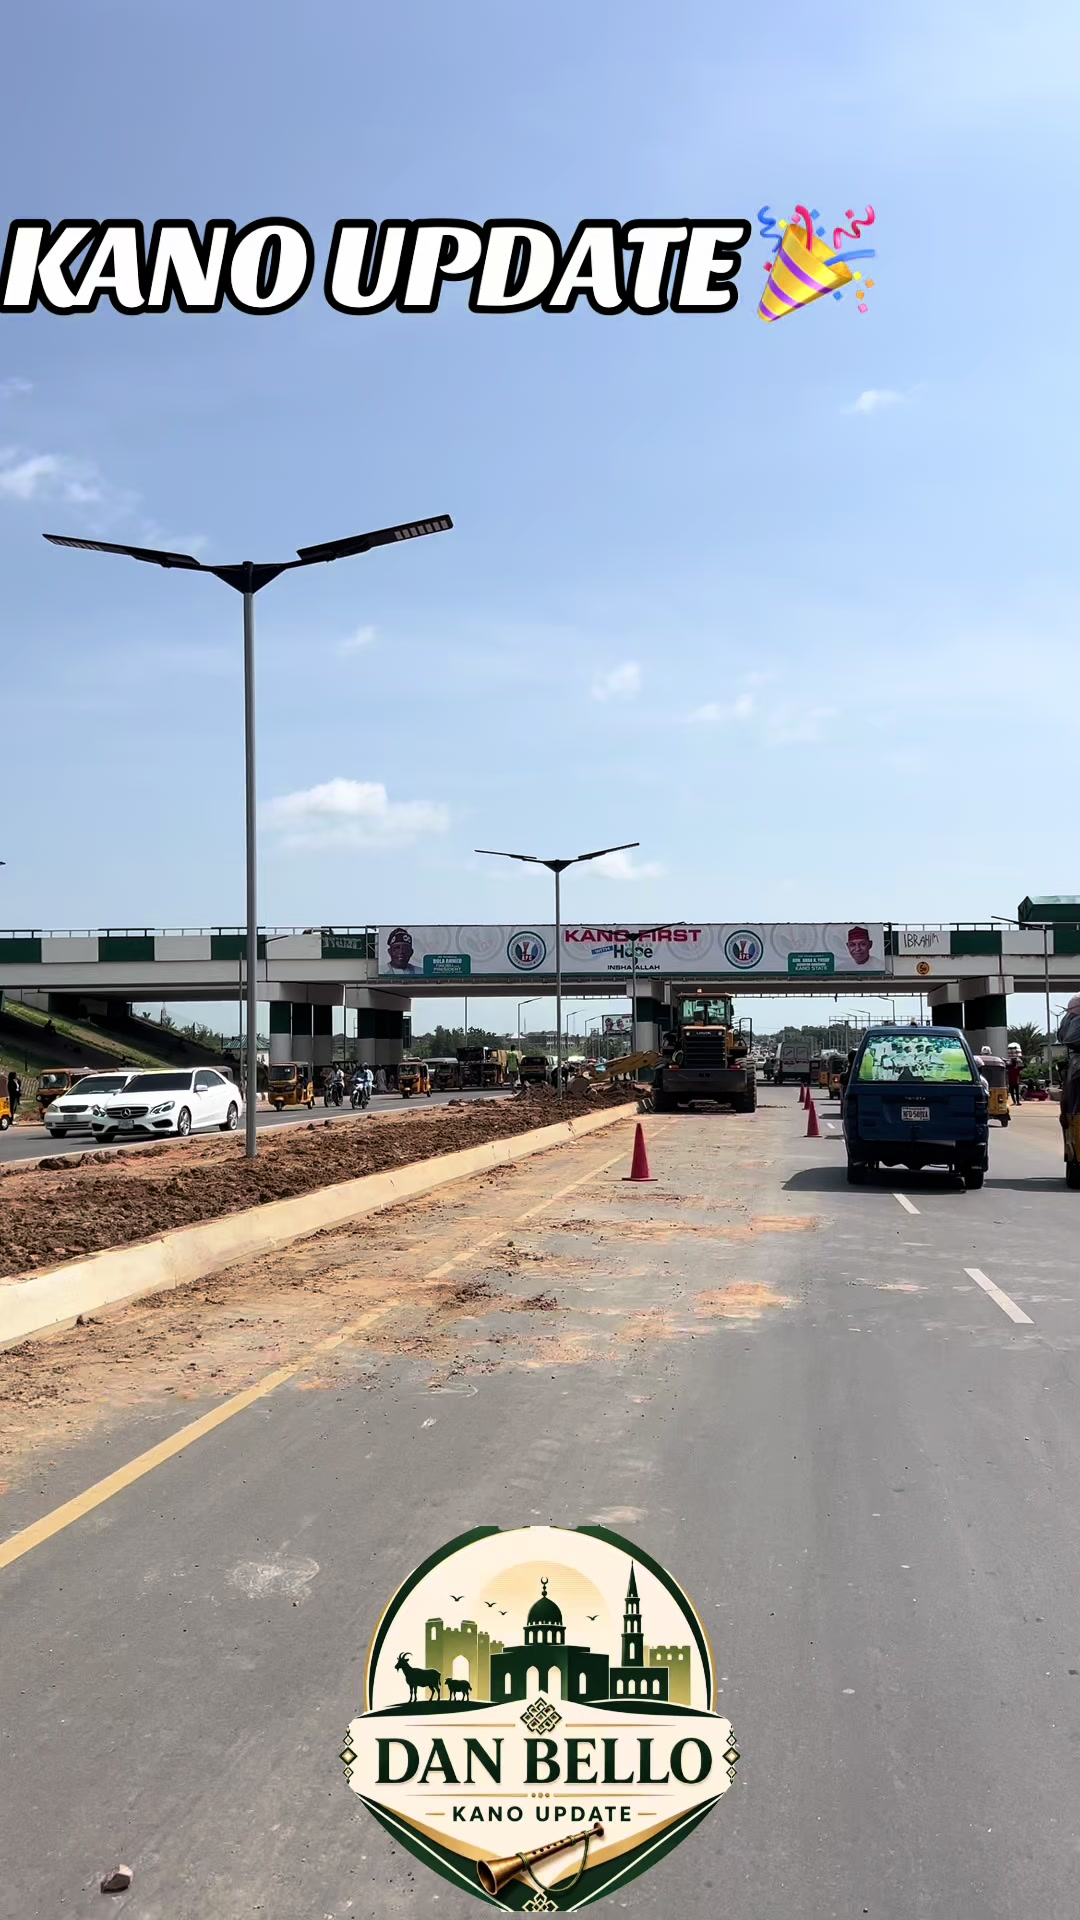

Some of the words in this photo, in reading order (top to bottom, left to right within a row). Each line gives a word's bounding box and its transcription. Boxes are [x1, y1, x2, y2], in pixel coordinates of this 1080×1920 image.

[565, 929, 630, 943] KANO
[638, 929, 702, 943] FIRST
[613, 944, 653, 965] Hope
